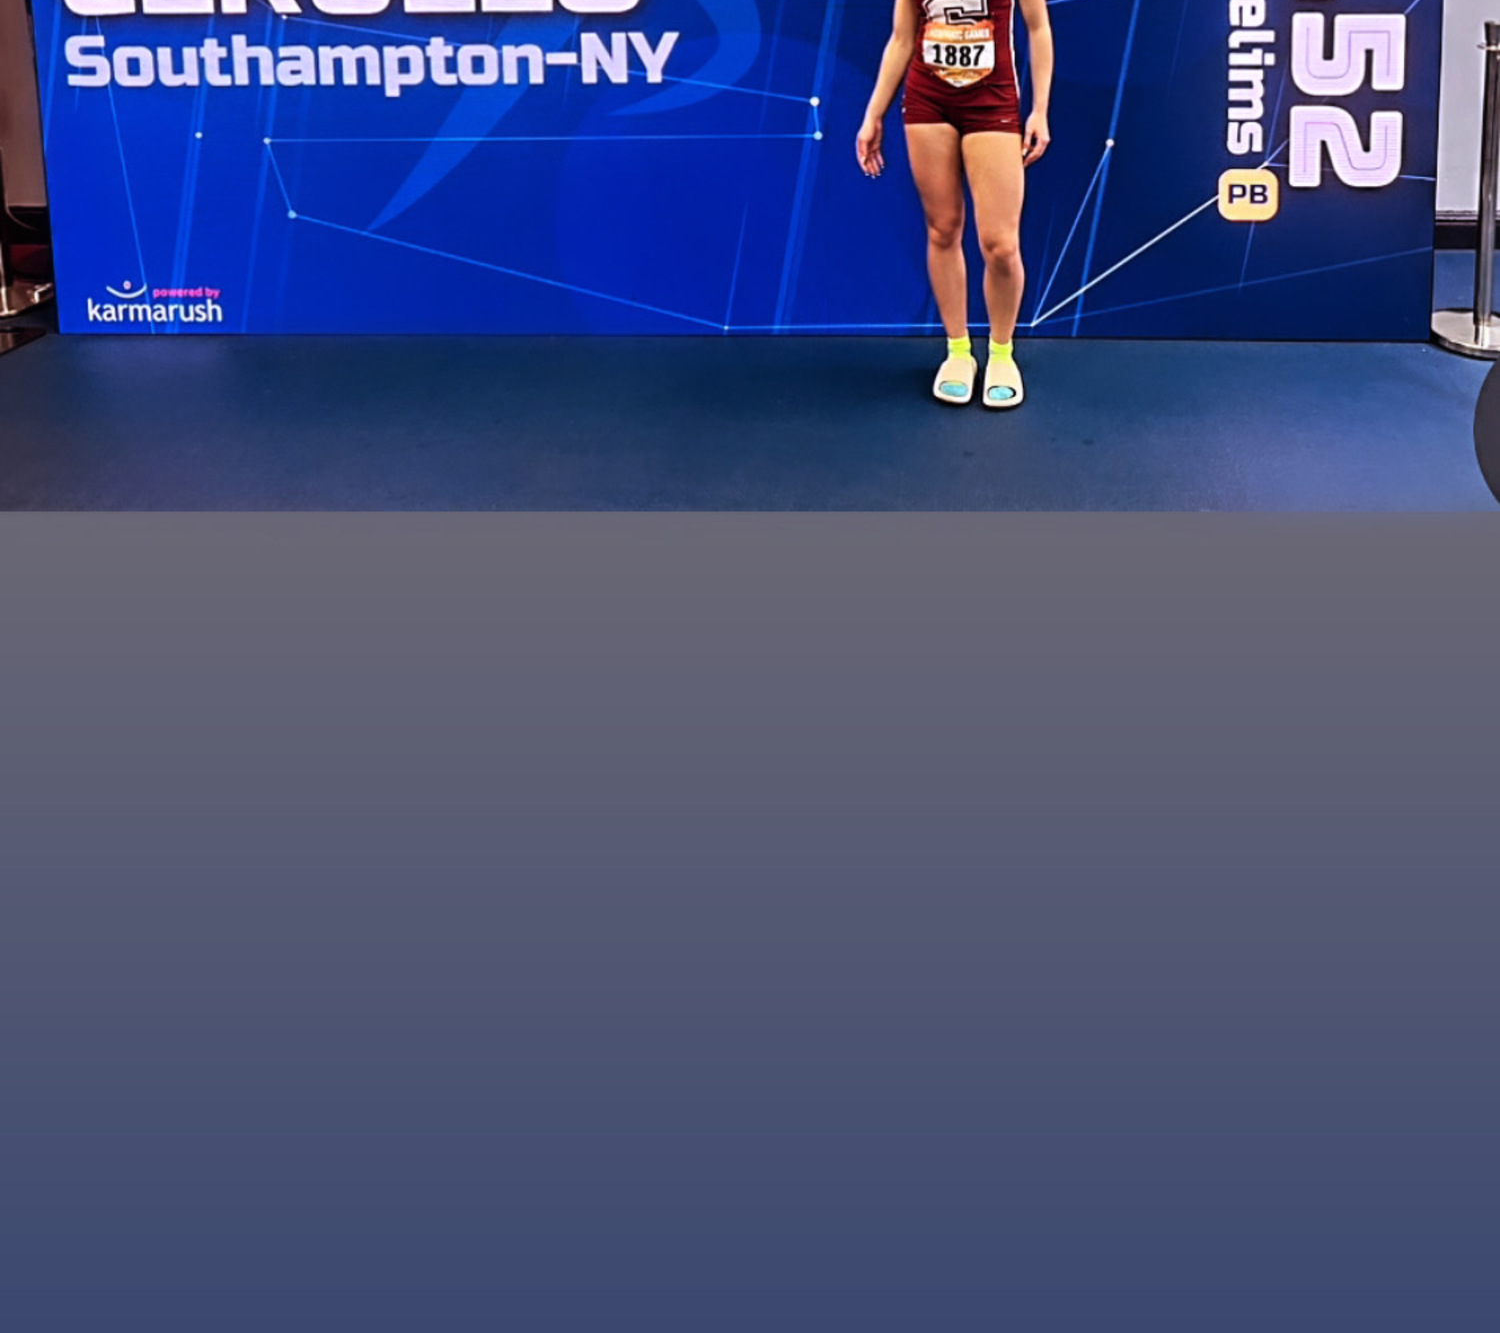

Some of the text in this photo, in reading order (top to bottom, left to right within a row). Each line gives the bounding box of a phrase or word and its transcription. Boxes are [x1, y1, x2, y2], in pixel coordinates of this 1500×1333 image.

[64, 31, 680, 97] Southampton-NY
[932, 43, 985, 67] 1887
[1227, 183, 1269, 204] PB
[152, 286, 221, 299] powered by
[87, 297, 223, 322] karmarush
